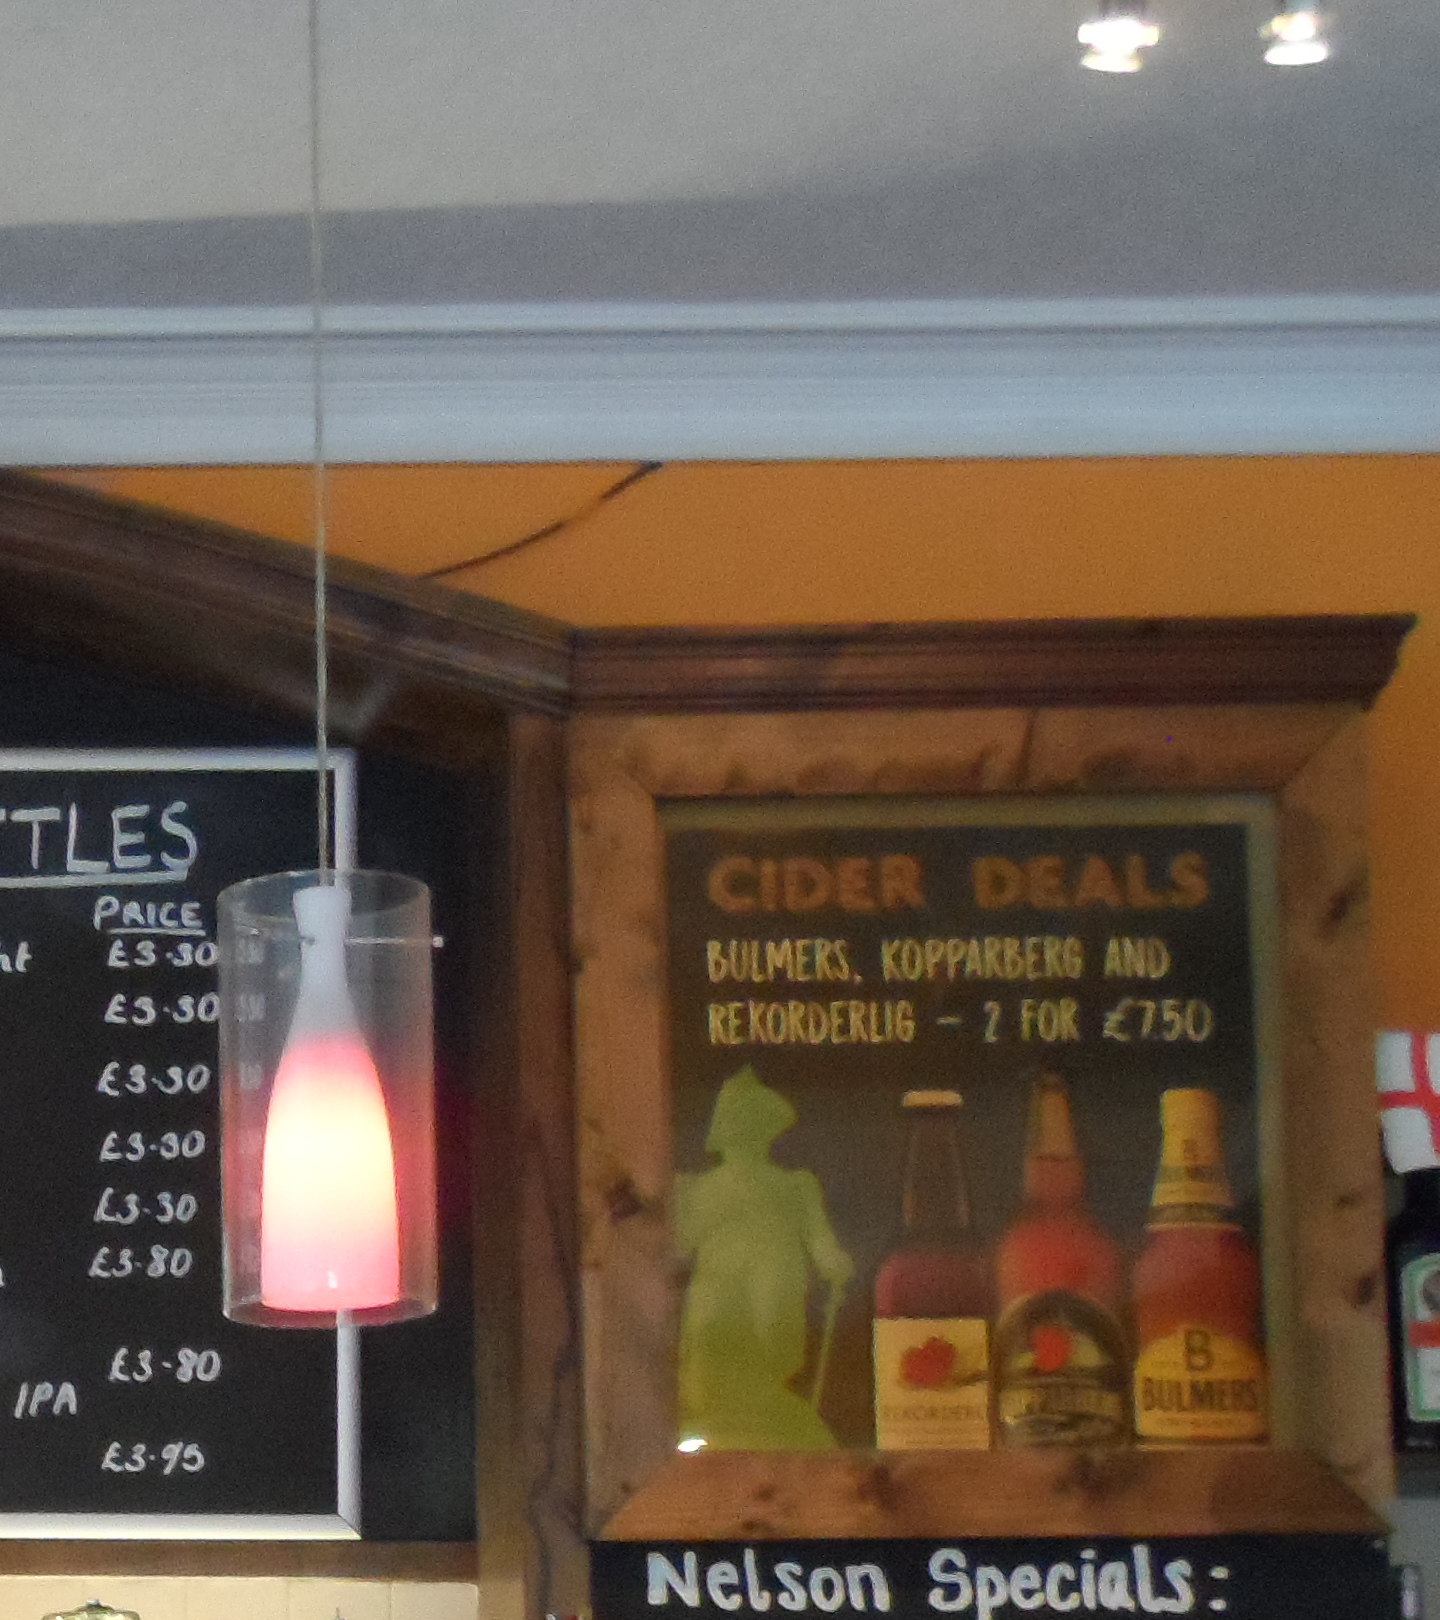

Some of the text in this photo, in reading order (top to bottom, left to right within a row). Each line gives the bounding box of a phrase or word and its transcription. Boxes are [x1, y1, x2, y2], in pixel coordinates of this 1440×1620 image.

[707, 852, 1210, 915] CIDER DEALS
[93, 895, 203, 930] PRICE
[881, 935, 1084, 982] KOPPARBERG
[1105, 936, 1170, 979] AND
[708, 999, 916, 1045] REKORDERLIG
[983, 1000, 1001, 1044] 2
[1020, 998, 1079, 1043] FOR
[14, 1382, 78, 1419] IPA
[645, 1551, 891, 1613] Nelson
